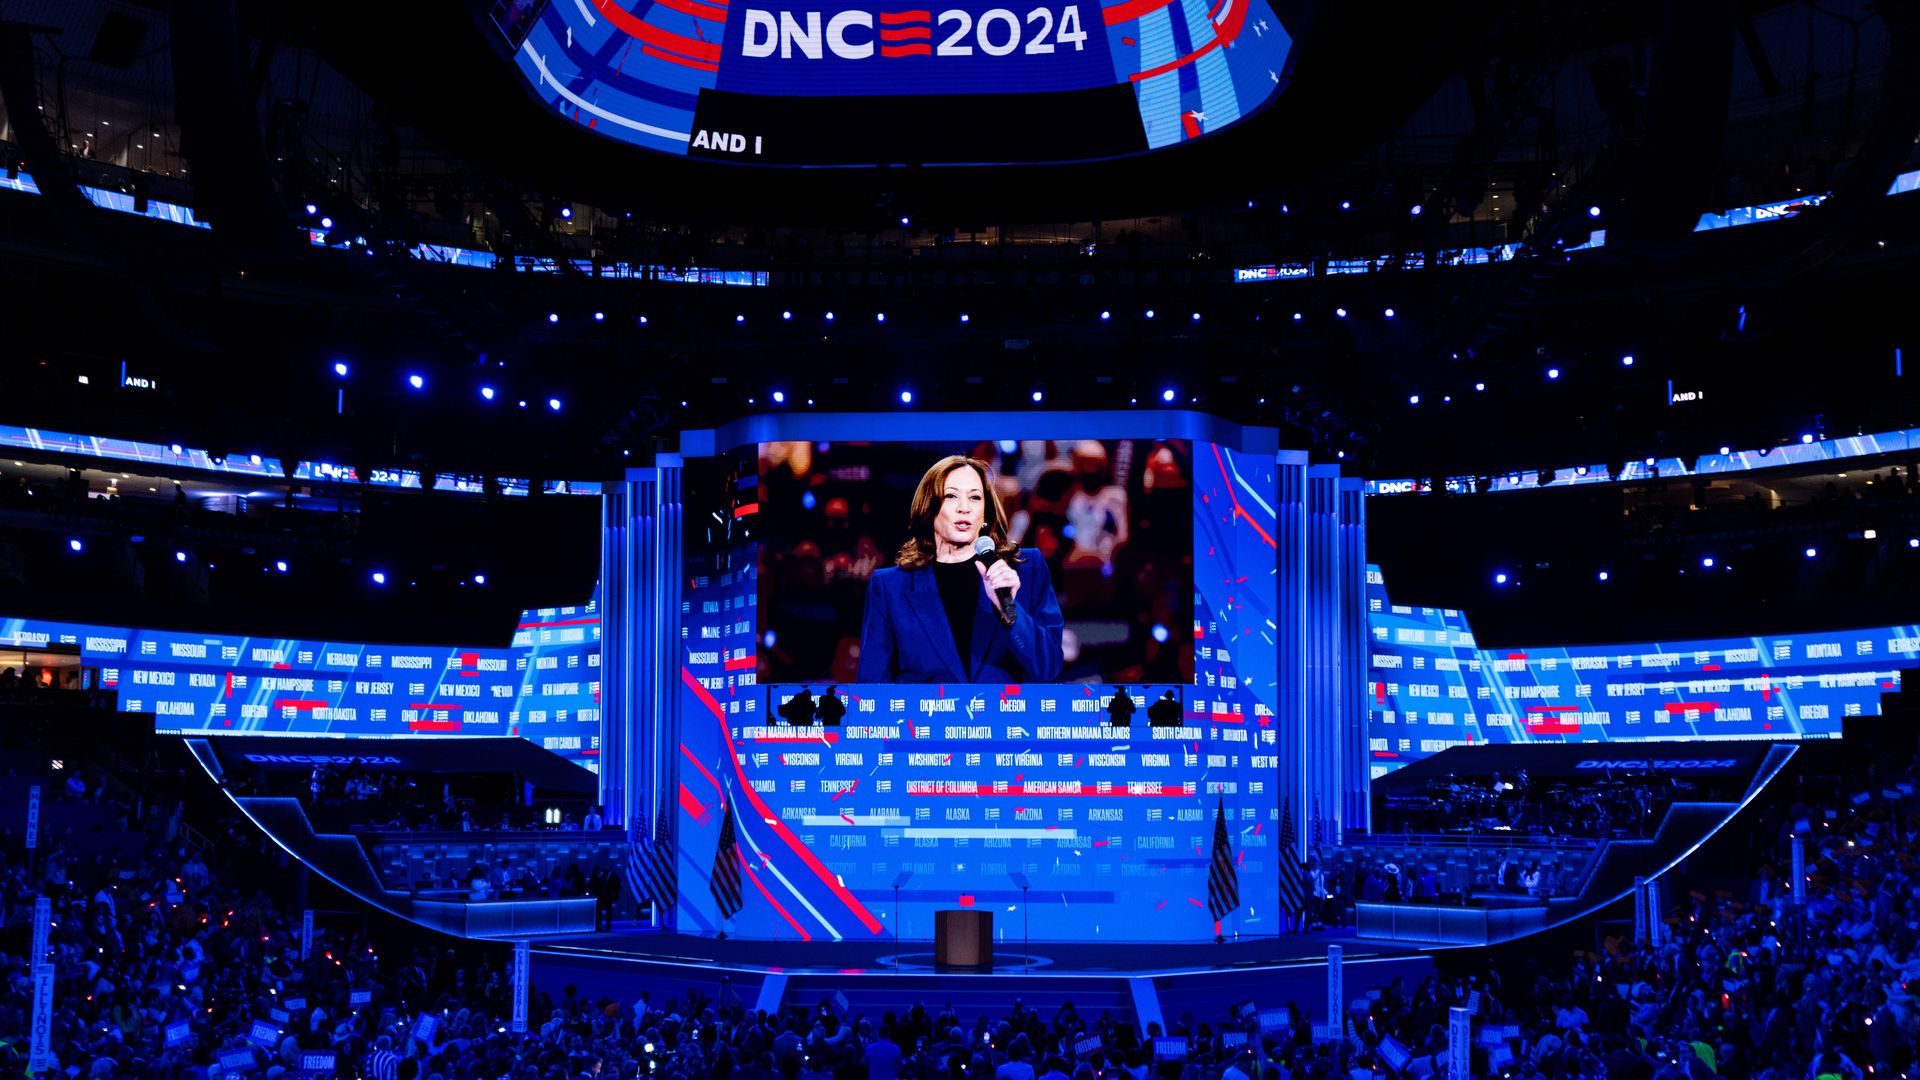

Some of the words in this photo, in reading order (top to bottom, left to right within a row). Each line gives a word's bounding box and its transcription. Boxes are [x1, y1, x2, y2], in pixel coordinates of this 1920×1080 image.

[743, 10, 873, 59] DNC
[937, 7, 1087, 55] 2024
[693, 130, 746, 152] AND
[756, 136, 761, 154] I
[1756, 203, 1790, 219] DNC
[1239, 269, 1267, 279] DNC
[126, 377, 148, 387] AND
[1673, 392, 1696, 401] AND
[1699, 391, 1702, 399] I
[1379, 482, 1413, 493] DNC
[702, 627, 719, 638] MAINE
[86, 637, 126, 652] MISSISSIPPI
[172, 643, 206, 658] MISSOURI
[1807, 644, 1841, 658] MONTANA
[252, 648, 284, 663] MONTANA
[327, 653, 358, 666] NEBRASKA
[392, 656, 432, 668] MISSISSIPPI
[690, 652, 718, 664] MISSOURI
[1725, 648, 1758, 663] MISSOURI
[477, 659, 507, 671] MISSOURI
[1494, 658, 1526, 672] MONTANA
[1572, 657, 1608, 670] NEBRASKA
[133, 671, 148, 683] NEW
[149, 672, 175, 685] MEXICO
[190, 674, 215, 687] NEVADA
[262, 676, 276, 690] NEW
[277, 678, 314, 692] HAMPSHIRE
[1744, 677, 1770, 692] NEVADA
[1820, 674, 1837, 688] NEW
[1838, 672, 1876, 688] HAMPSHIRE
[356, 682, 369, 694] NEW
[371, 682, 393, 694] JERSEY
[440, 684, 454, 696] NEW
[456, 685, 480, 696] MEXICO
[493, 686, 513, 698] NEVADA
[1505, 686, 1520, 698] NEW
[1521, 685, 1559, 698] HAMPSHIRE
[1607, 684, 1624, 696] NEW
[1624, 683, 1645, 696] JERSEY
[1689, 680, 1704, 694] NEW
[1705, 678, 1730, 693] MEXICO
[156, 702, 194, 715] OKLAHOMA
[241, 704, 268, 718] OREGON
[860, 699, 875, 712] OHIO
[1000, 700, 1025, 712] OREGON
[1072, 700, 1093, 712] NORTH
[1800, 705, 1828, 719] OREGON
[312, 707, 332, 720] NORTH
[331, 708, 356, 720] DAKOTA
[402, 710, 418, 722] OHIO
[464, 712, 498, 723] OKLAHOMA
[1487, 714, 1512, 726] OREGON
[1560, 712, 1582, 726] NORTH
[1582, 712, 1610, 724] DAKOTA
[1655, 710, 1670, 723] OHIO
[1714, 708, 1751, 721] OKLAHOMA
[767, 726, 796, 739] MARIANA
[797, 726, 824, 739] ISLANDS
[846, 726, 868, 738] SOUTH
[869, 726, 899, 738] CAROLINA
[945, 727, 966, 739] SOUTH
[968, 727, 991, 739] DAKOTA
[1037, 727, 1071, 739] NORTHERN
[1072, 727, 1101, 739] MARIANA
[1102, 727, 1130, 740] ISLANDS
[1152, 727, 1174, 740] SOUTH
[1175, 727, 1202, 740] CAROLINA
[784, 754, 820, 766] WISCONSIN
[835, 753, 863, 765] VIRGINIA
[908, 753, 950, 766] WASHINGTON
[996, 754, 1013, 766] WEST
[1014, 754, 1042, 766] VIRGINIA
[1089, 754, 1125, 766] WISCONSIN
[1142, 754, 1170, 766] VIRGINIA
[1252, 756, 1271, 768] WEST
[755, 780, 775, 792] SAMOA
[907, 781, 934, 793] DISTRICT
[936, 781, 944, 793] OF
[945, 780, 978, 793] COLUMBIA
[1024, 781, 1057, 793] AMERICAN
[1058, 781, 1081, 794] SAMOA
[1128, 781, 1162, 794] TENNESSEE
[29, 792, 38, 840] MAINE
[782, 808, 816, 820] ARKANSAS
[870, 808, 900, 820] ALABAMA
[946, 808, 970, 820] ALASKA
[1015, 808, 1042, 821] ARIZONA
[1088, 808, 1123, 821] ARKANSAS
[1177, 809, 1203, 821] ALABAMA
[830, 834, 866, 847] CALIFORNIA
[914, 836, 938, 848] ALASKA
[984, 836, 1011, 848] ARIZONA
[1057, 836, 1092, 848] ARKANSAS
[1138, 836, 1174, 848] CALIFORNIA
[1241, 834, 1266, 847] ARIZONA
[981, 863, 1006, 876] FLORIDA
[36, 976, 48, 1055] ILLINOIS
[252, 1024, 276, 1042] FREEDOM
[1074, 1035, 1101, 1055] FREEDOM
[1156, 1040, 1186, 1055] FREEDOM
[303, 1055, 334, 1070] FREEDOM
